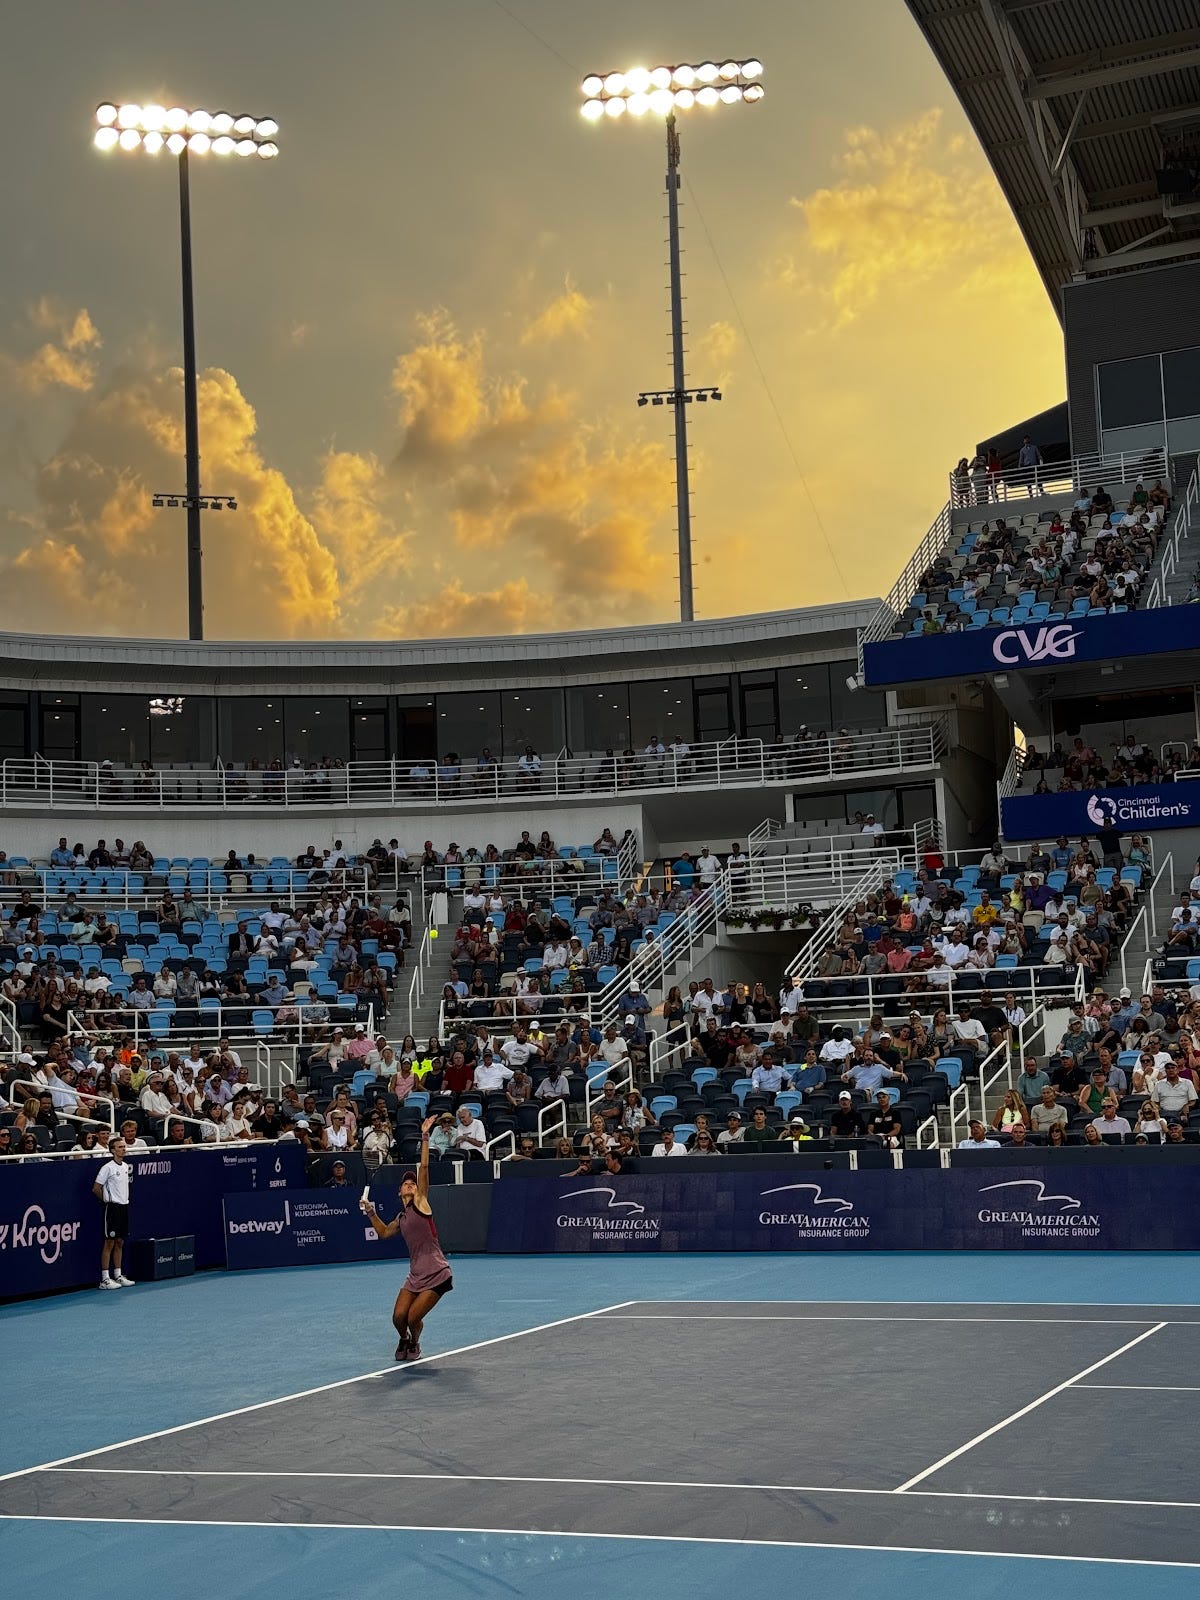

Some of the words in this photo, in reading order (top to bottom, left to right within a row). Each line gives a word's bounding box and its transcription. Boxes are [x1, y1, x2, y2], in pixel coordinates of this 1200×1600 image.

[993, 624, 1084, 664] CVG
[1118, 796, 1160, 807] Cincinnati
[1119, 803, 1189, 820] Children's
[275, 1157, 282, 1173] 6
[269, 1179, 287, 1188] SERVE
[294, 1203, 329, 1211] VERONIKA
[294, 1208, 349, 1217] KUDERMETOVA
[229, 1220, 284, 1235] betway
[1021, 1227, 1069, 1237] INSURANCE
[1071, 1227, 1100, 1237] GROUP
[12, 1205, 80, 1264] Kroger
[296, 1229, 321, 1237] MAGDA
[592, 1230, 633, 1240] INSURANCE
[634, 1230, 659, 1239] GROUP
[798, 1229, 842, 1238] INSURANCE
[843, 1228, 870, 1237] GROUP
[297, 1235, 326, 1243] LINETTE
